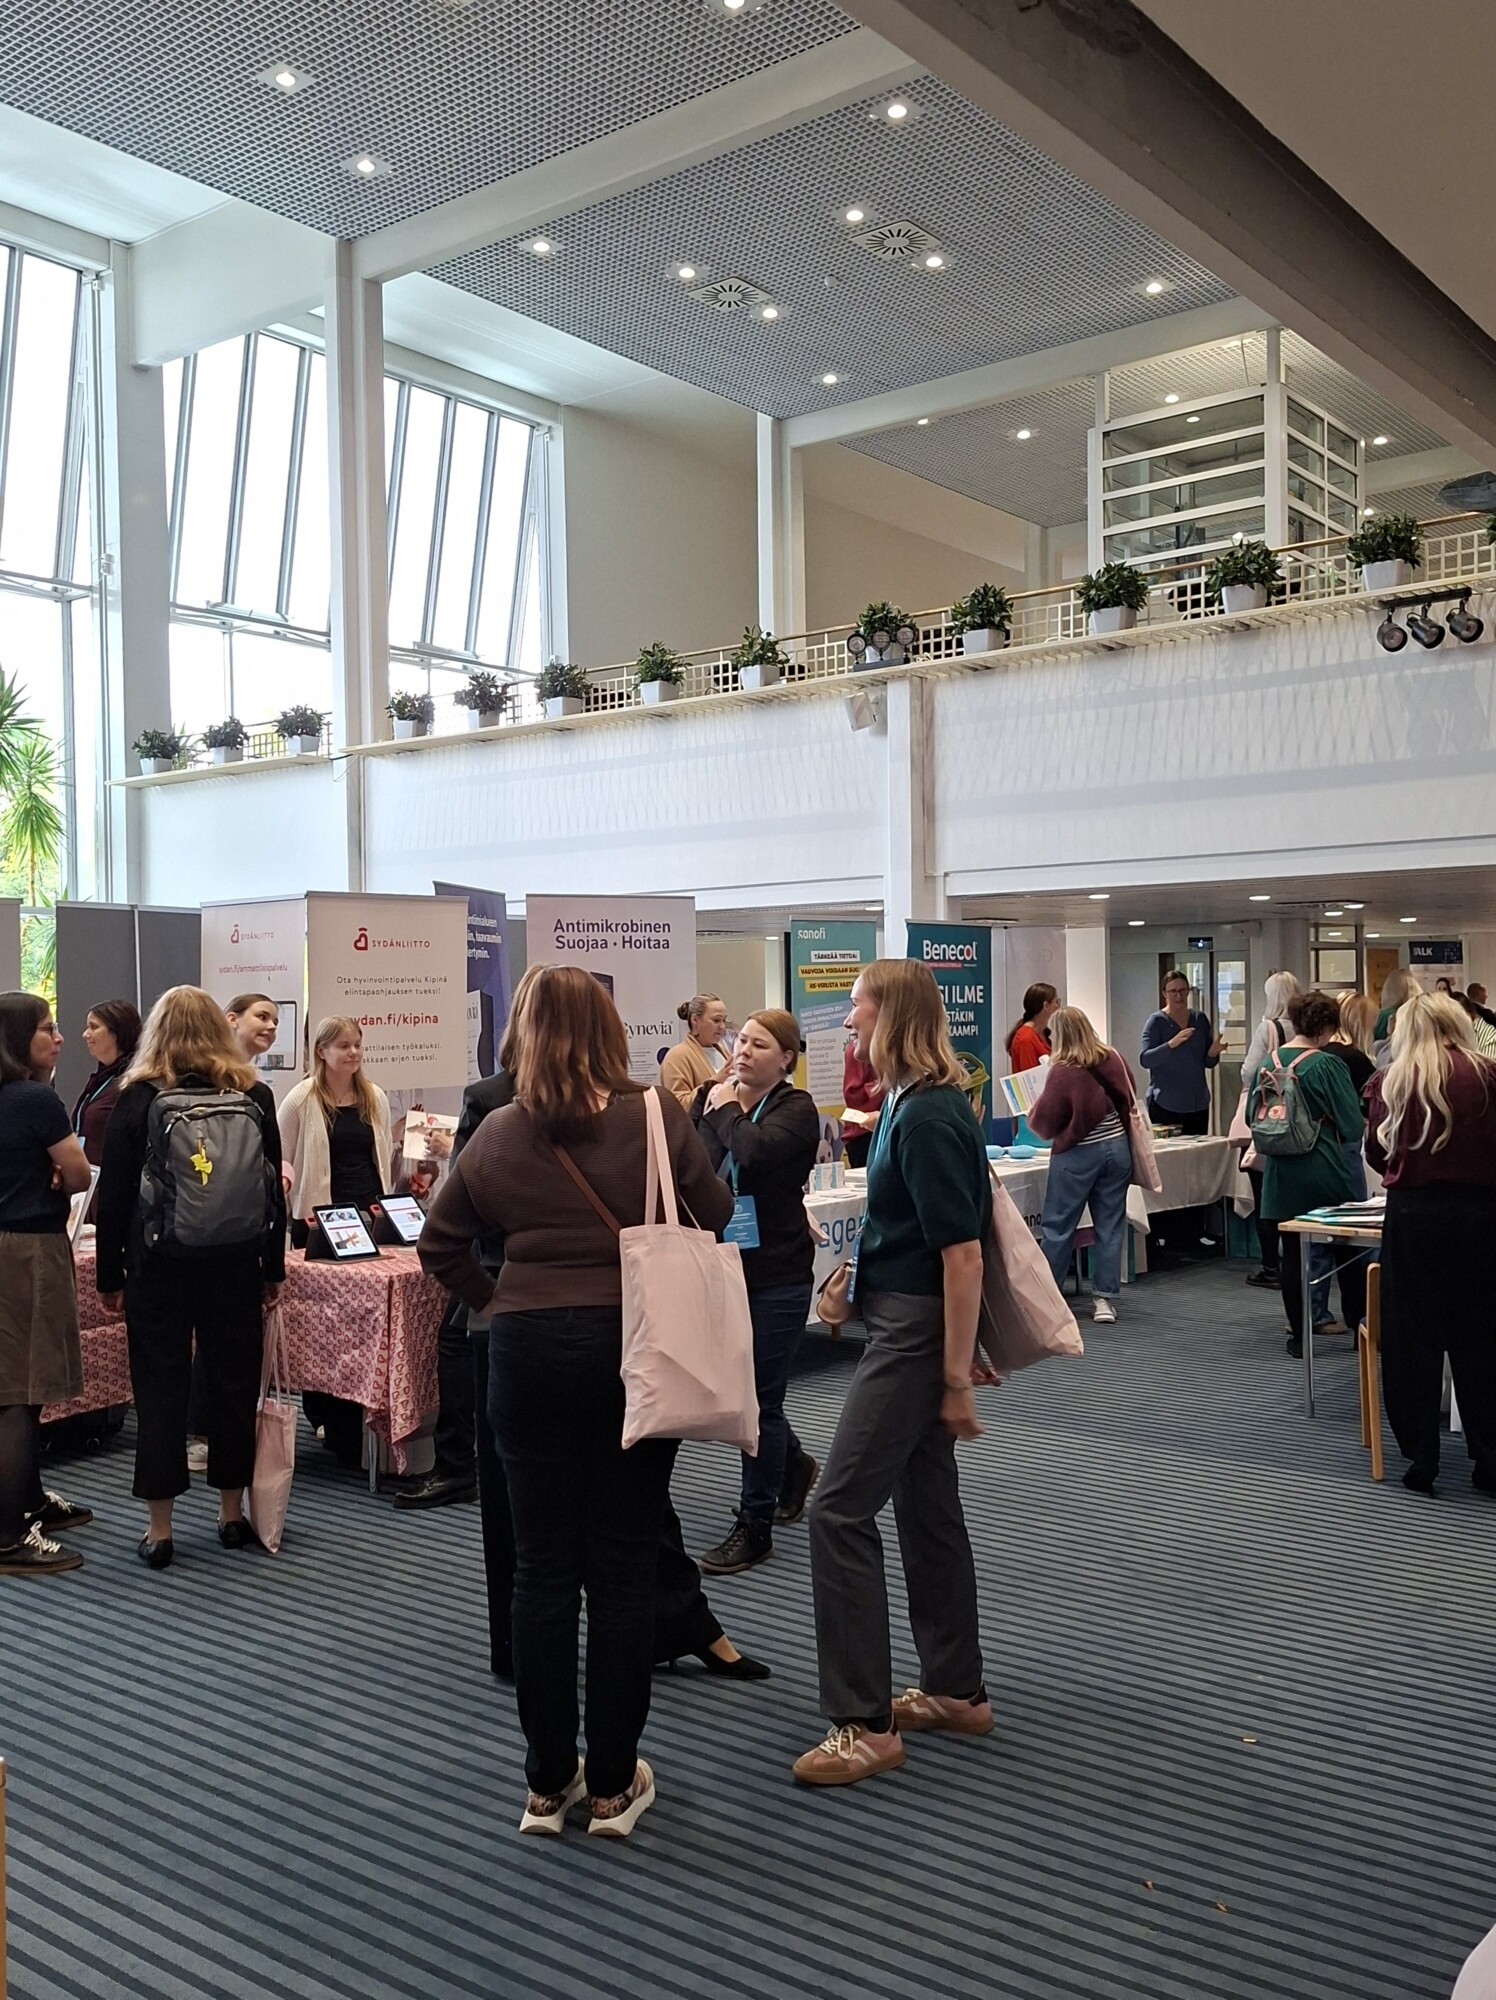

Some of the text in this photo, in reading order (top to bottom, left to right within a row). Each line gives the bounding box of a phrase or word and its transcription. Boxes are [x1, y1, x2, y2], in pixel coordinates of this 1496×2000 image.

[553, 918, 671, 933] Antimikrobinen
[797, 927, 826, 940] sanofi
[371, 938, 431, 948] SYDÄNLIITTO
[555, 935, 670, 952] Suojaa Hoitaa
[922, 939, 978, 961] Benecol
[336, 974, 448, 987] Ota hyvinvointipalvelu Kipinä
[344, 987, 441, 997] elintapaohjauksen tueksi!
[952, 985, 984, 1003] ILME
[351, 1012, 439, 1028] ydan.fi/kipina
[391, 1055, 410, 1064] arjen
